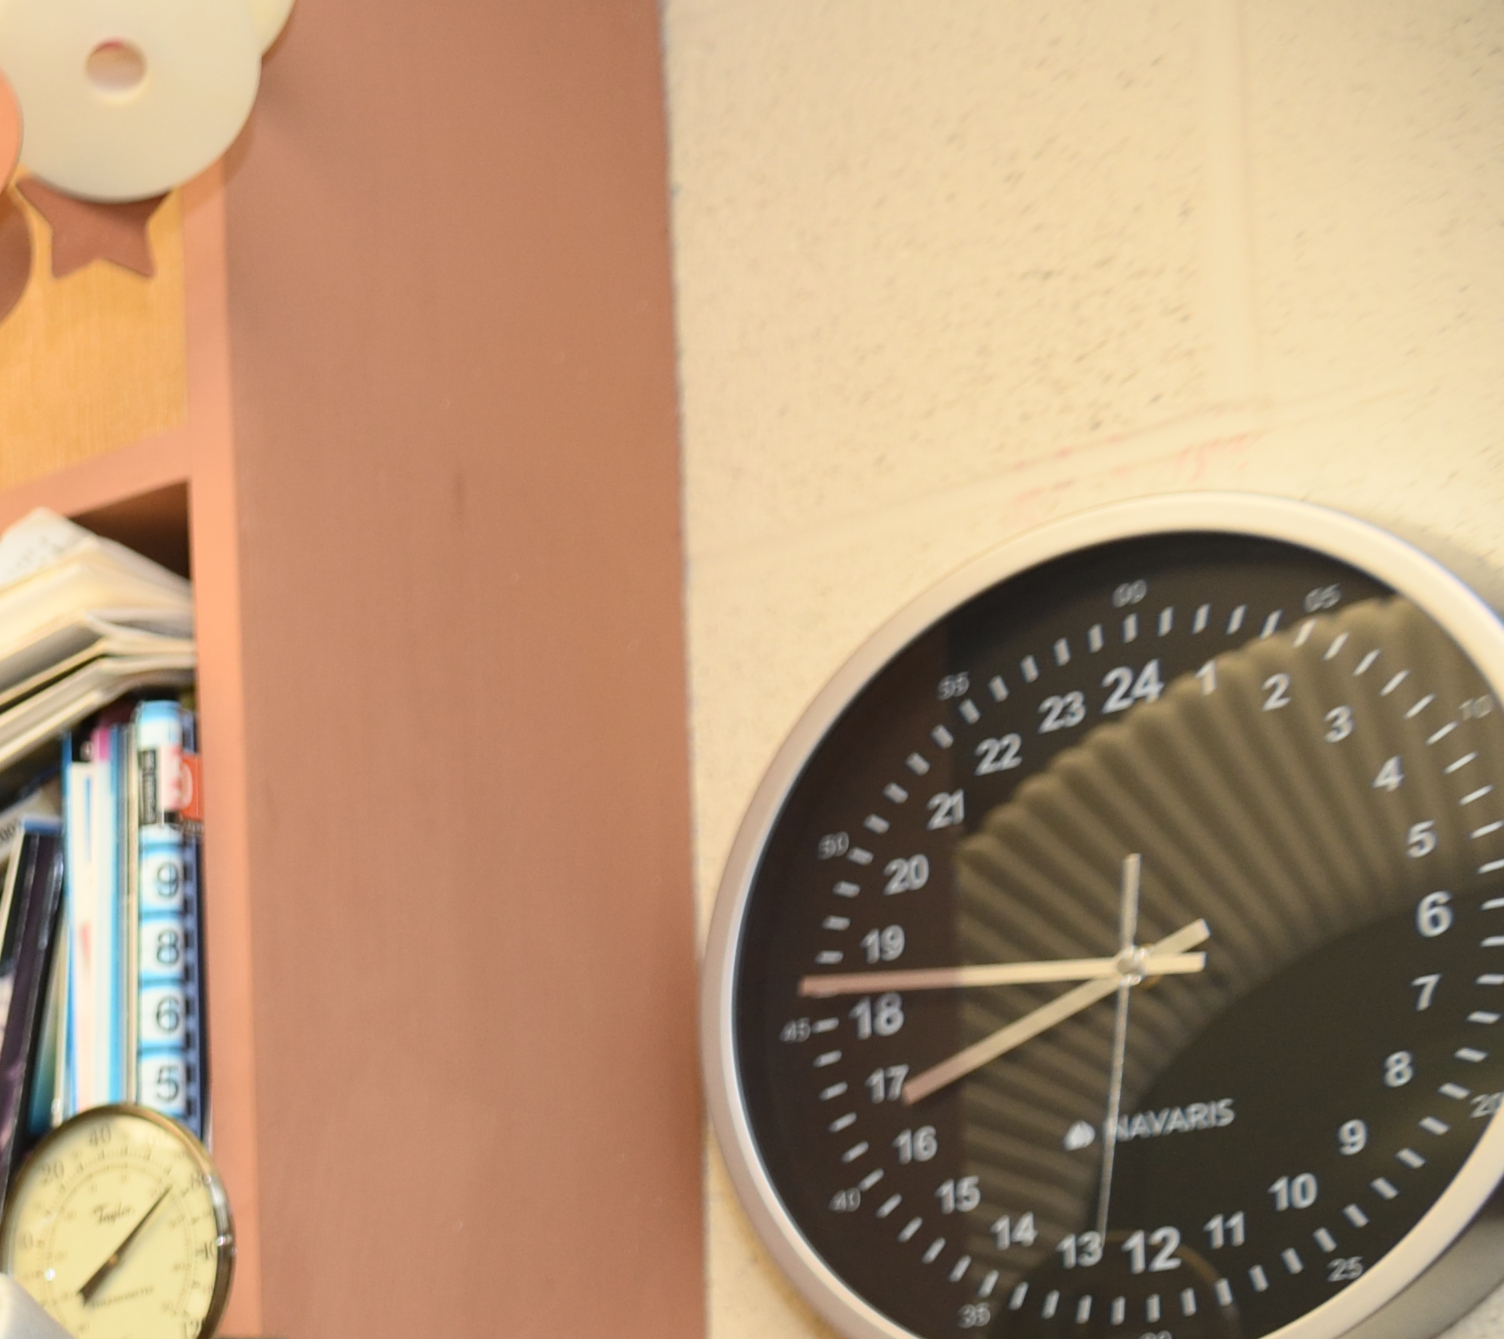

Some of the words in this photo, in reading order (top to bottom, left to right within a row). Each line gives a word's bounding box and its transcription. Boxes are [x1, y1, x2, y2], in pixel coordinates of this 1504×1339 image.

[1102, 659, 1163, 714] 24
[1196, 659, 1216, 695] 1
[1262, 673, 1290, 711] 2
[1038, 692, 1085, 733] 23
[1324, 705, 1354, 742] 3
[975, 733, 1022, 775] 22
[1373, 756, 1403, 791] 4
[928, 789, 965, 830] 21
[1407, 820, 1435, 858] 5
[884, 855, 929, 894] 20
[1416, 891, 1453, 937] 6
[861, 925, 905, 963] 19
[1411, 974, 1441, 1011] 7
[850, 993, 903, 1040] 18
[1384, 1051, 1413, 1087] 8
[893, 1126, 937, 1163] 16
[1338, 1119, 1368, 1155] 9
[936, 1177, 980, 1214] 15
[1268, 1173, 1318, 1211] 10
[992, 1212, 1037, 1249] 14
[1204, 1211, 1245, 1249] 11
[1057, 1231, 1103, 1268] 13
[1123, 1227, 1181, 1273] 12
